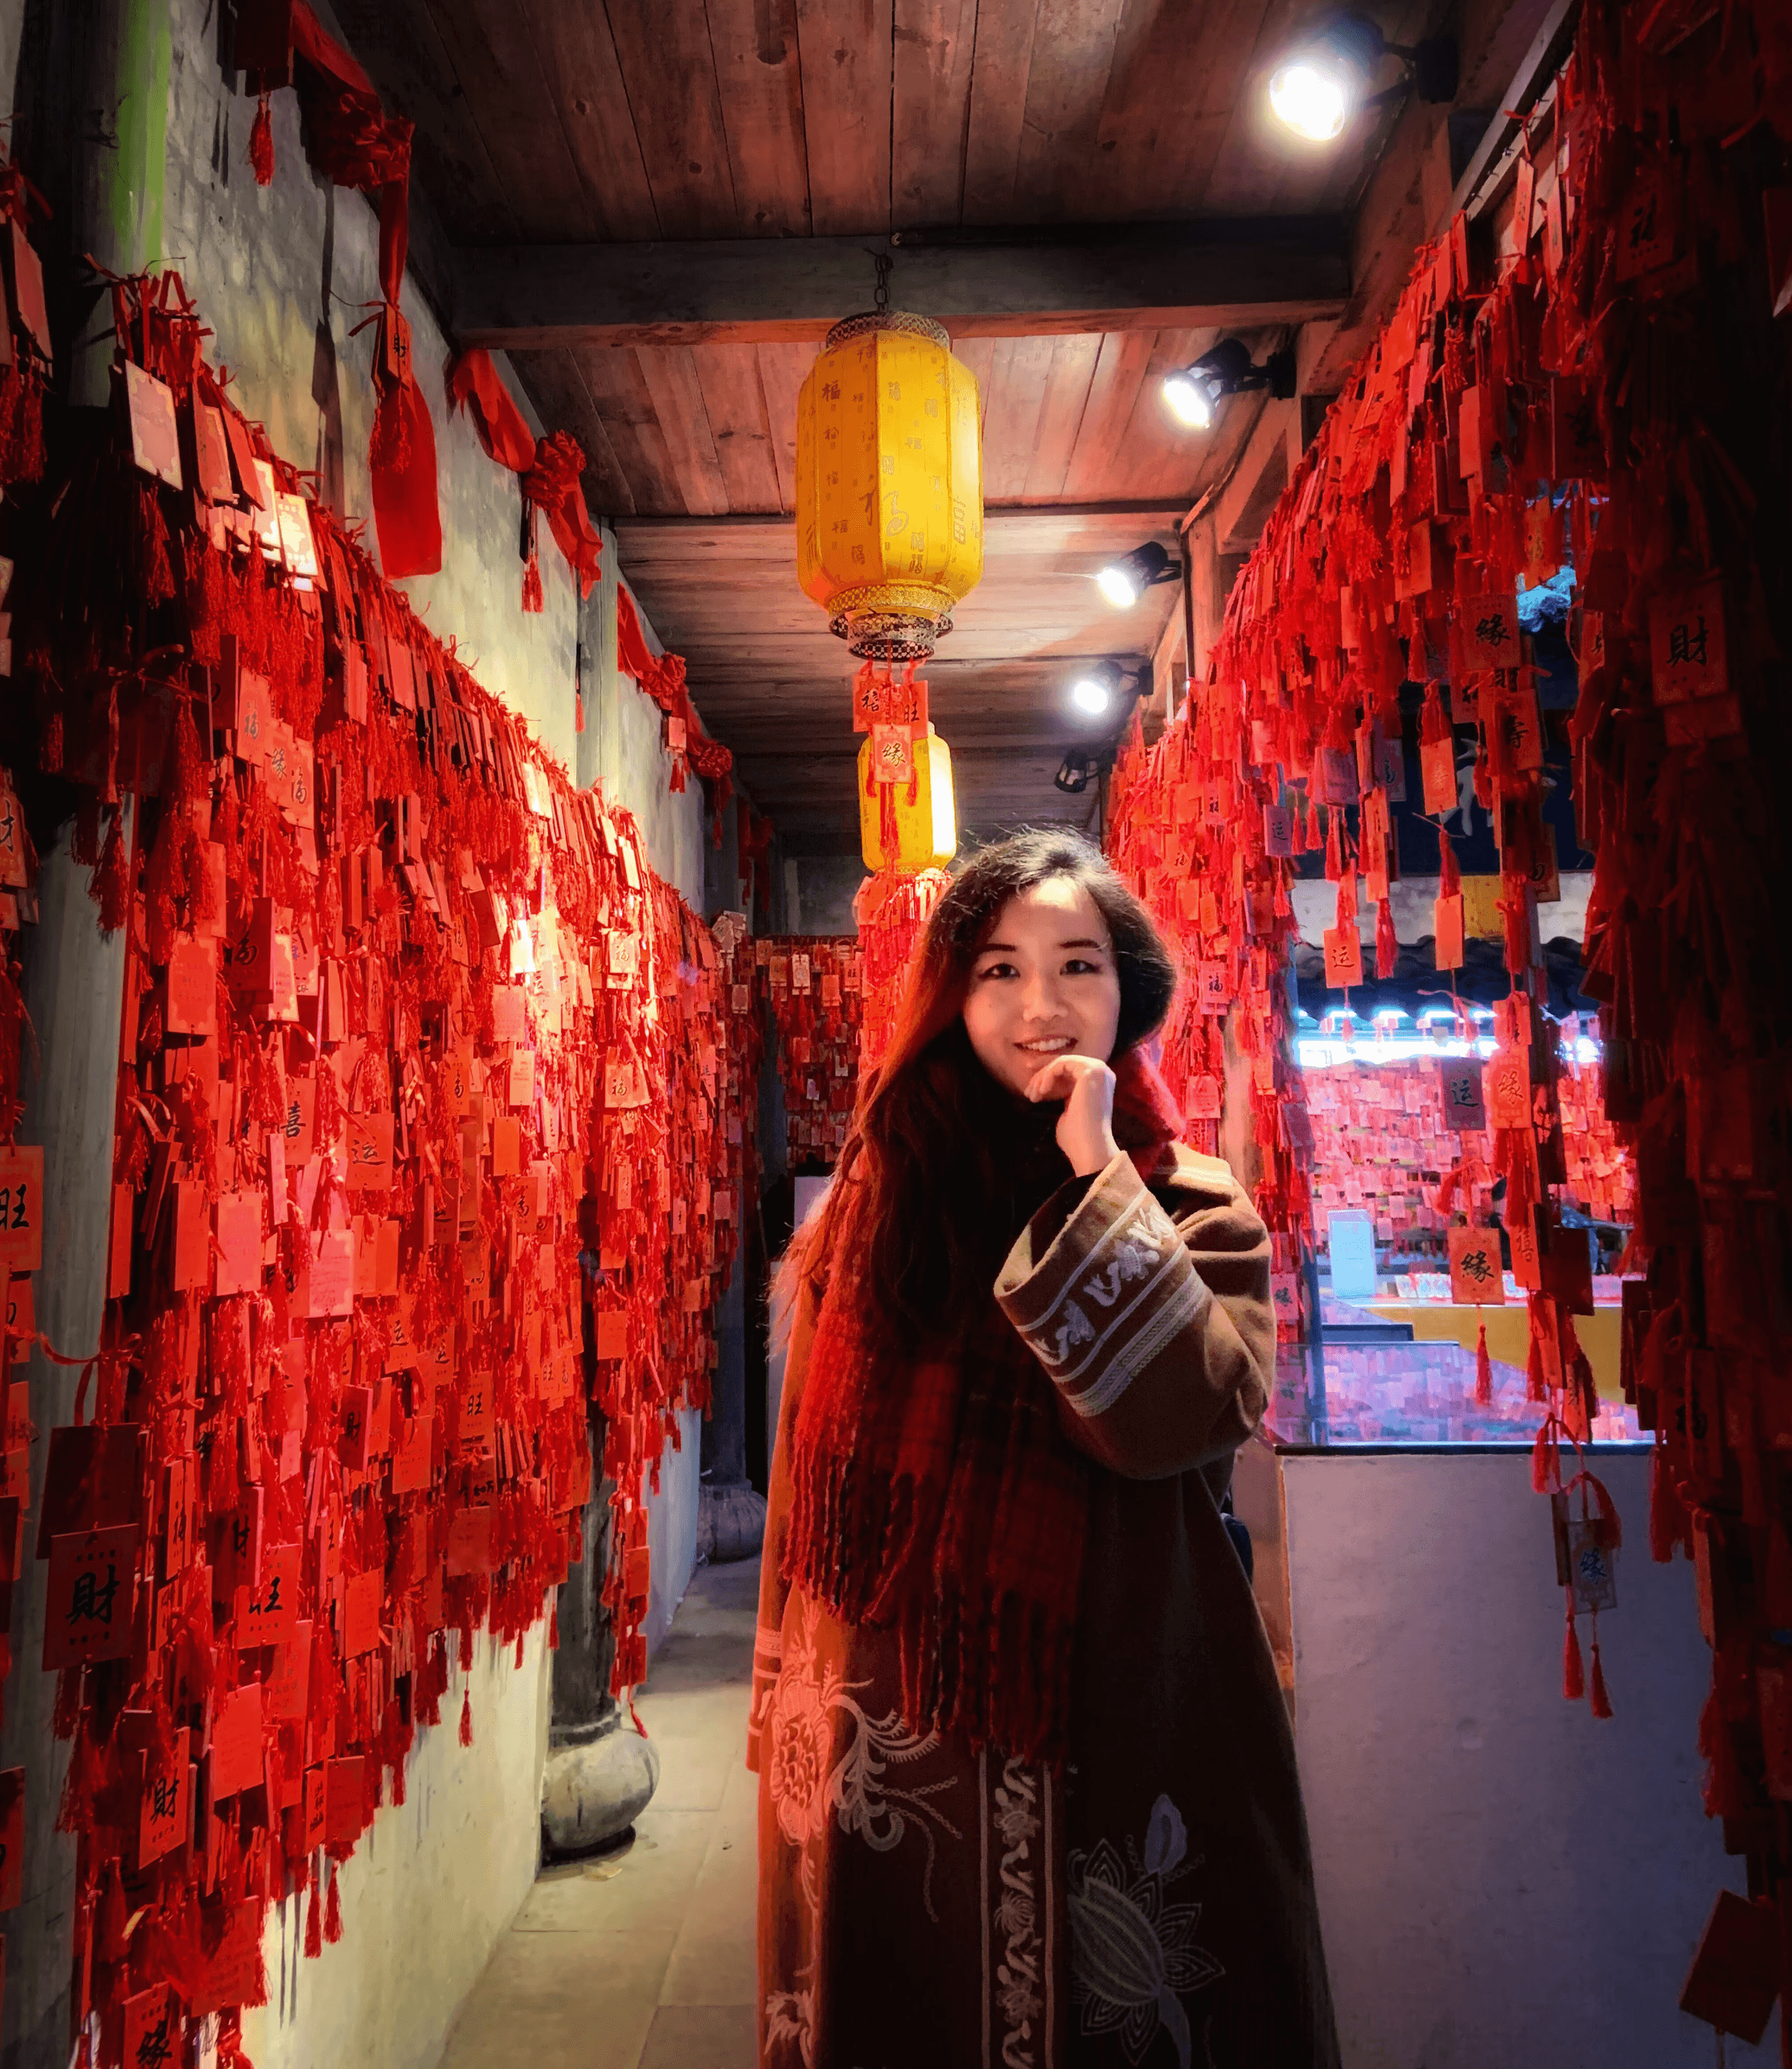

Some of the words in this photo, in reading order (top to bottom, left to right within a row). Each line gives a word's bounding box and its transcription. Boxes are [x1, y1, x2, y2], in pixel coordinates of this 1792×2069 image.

[1667, 616, 1710, 668] 財
[903, 701, 920, 724] 旺
[1331, 945, 1355, 969] 运
[1209, 972, 1224, 993] 福
[611, 1075, 628, 1097] 福
[1449, 1079, 1479, 1108] 运
[280, 1100, 307, 1138] 喜
[351, 1139, 387, 1166] 运
[467, 1392, 485, 1417] 旺
[69, 1564, 121, 1626] 財
[153, 1772, 180, 1823] 財
